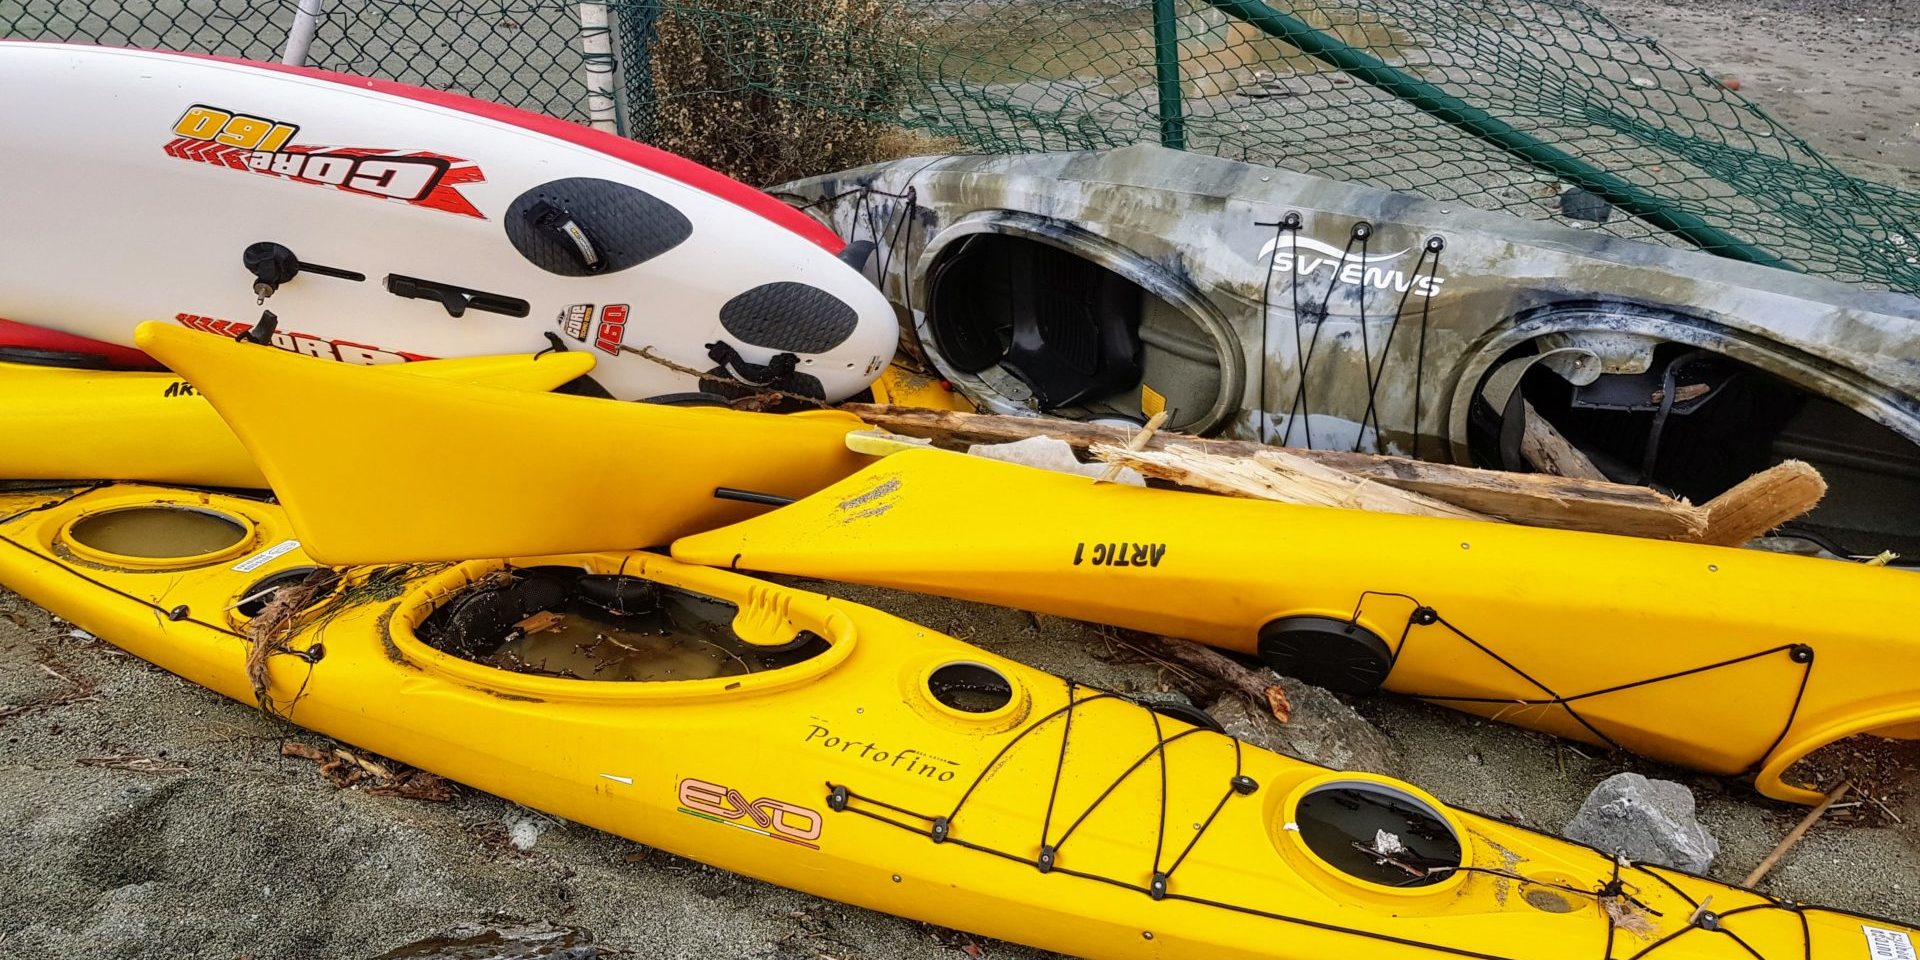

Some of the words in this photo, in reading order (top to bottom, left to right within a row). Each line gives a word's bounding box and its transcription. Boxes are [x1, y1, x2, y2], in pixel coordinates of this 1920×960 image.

[1272, 252, 1445, 298] SANBLAS
[164, 382, 202, 398] AR
[1073, 543, 1085, 566] 1
[1091, 543, 1166, 567] ARTIC
[805, 724, 956, 782] Portofino
[679, 778, 823, 841] EXO
